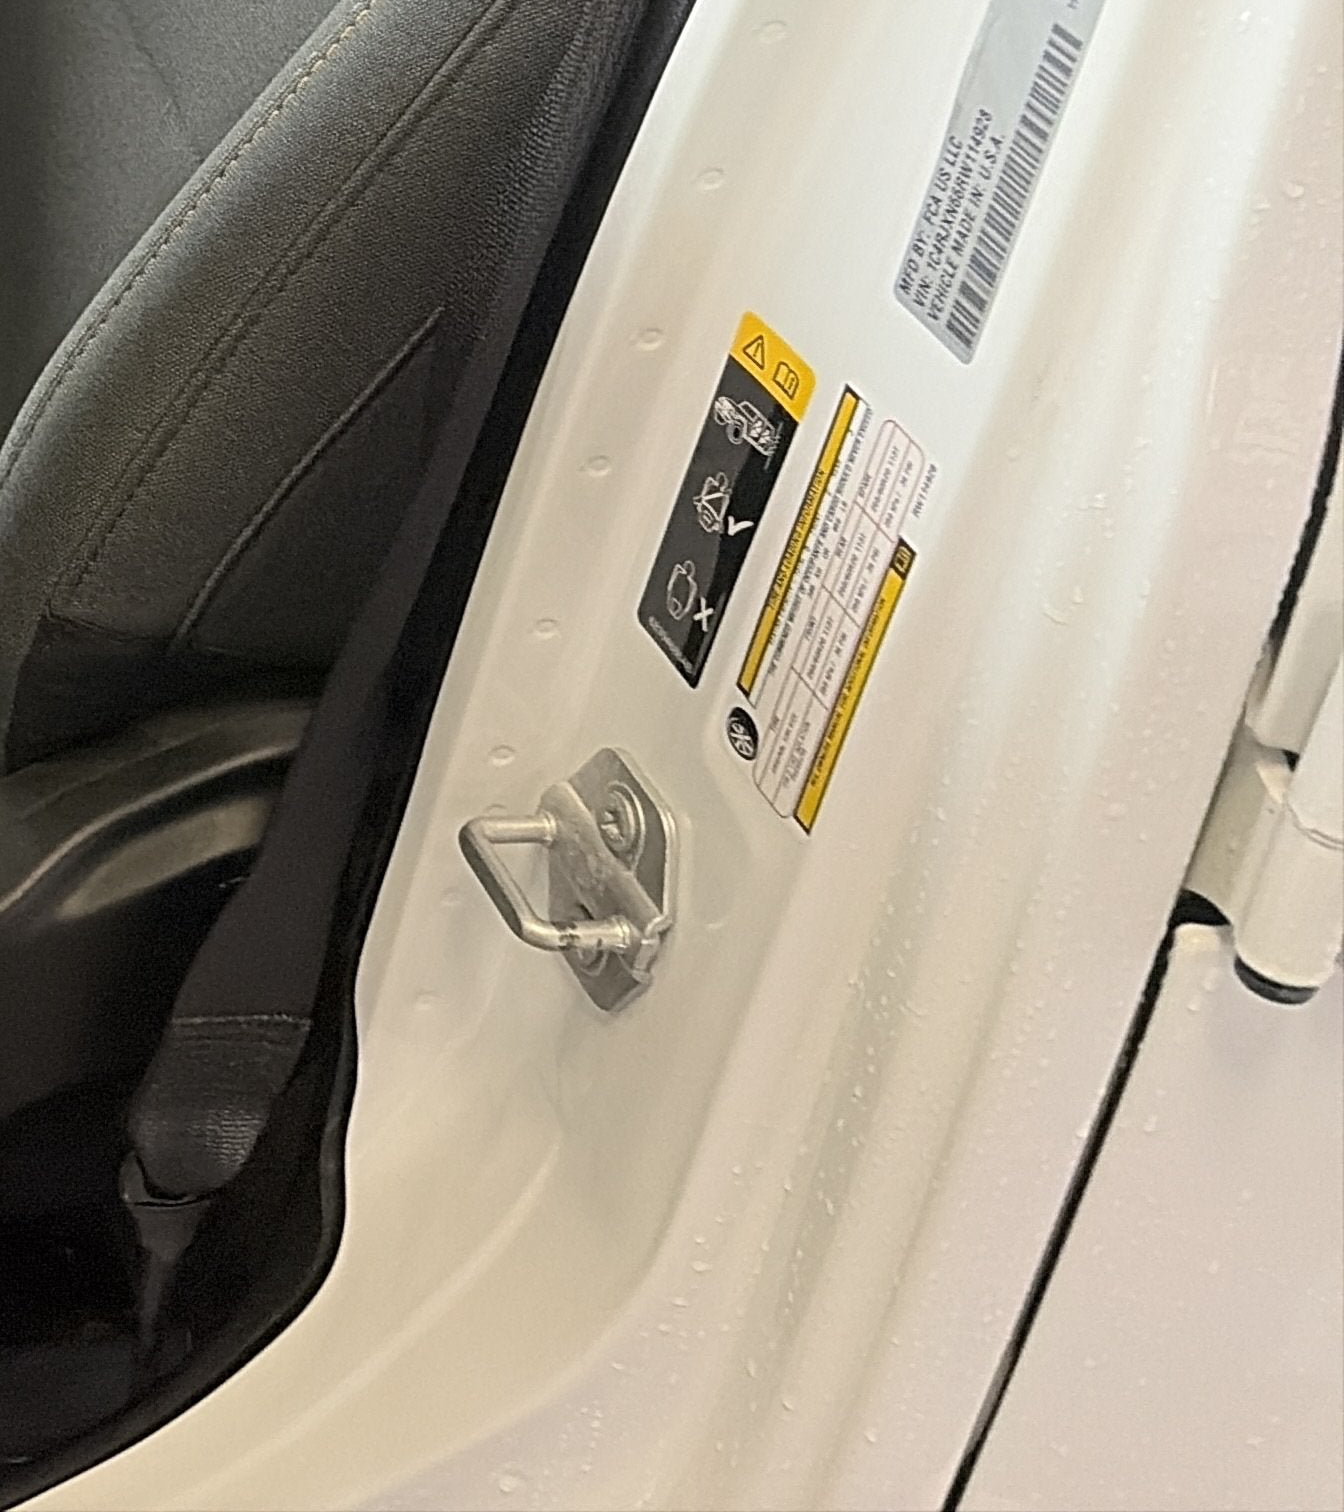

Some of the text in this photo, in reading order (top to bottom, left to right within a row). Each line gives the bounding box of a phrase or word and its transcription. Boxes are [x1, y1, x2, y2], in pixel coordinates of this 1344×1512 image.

[898, 135, 963, 295] MFD BY: FCA US LLC
[913, 109, 992, 307] VIN: 1C4RJXN66RW114928
[927, 134, 1005, 321] VEHICLE MADE IN: U.S.A.
